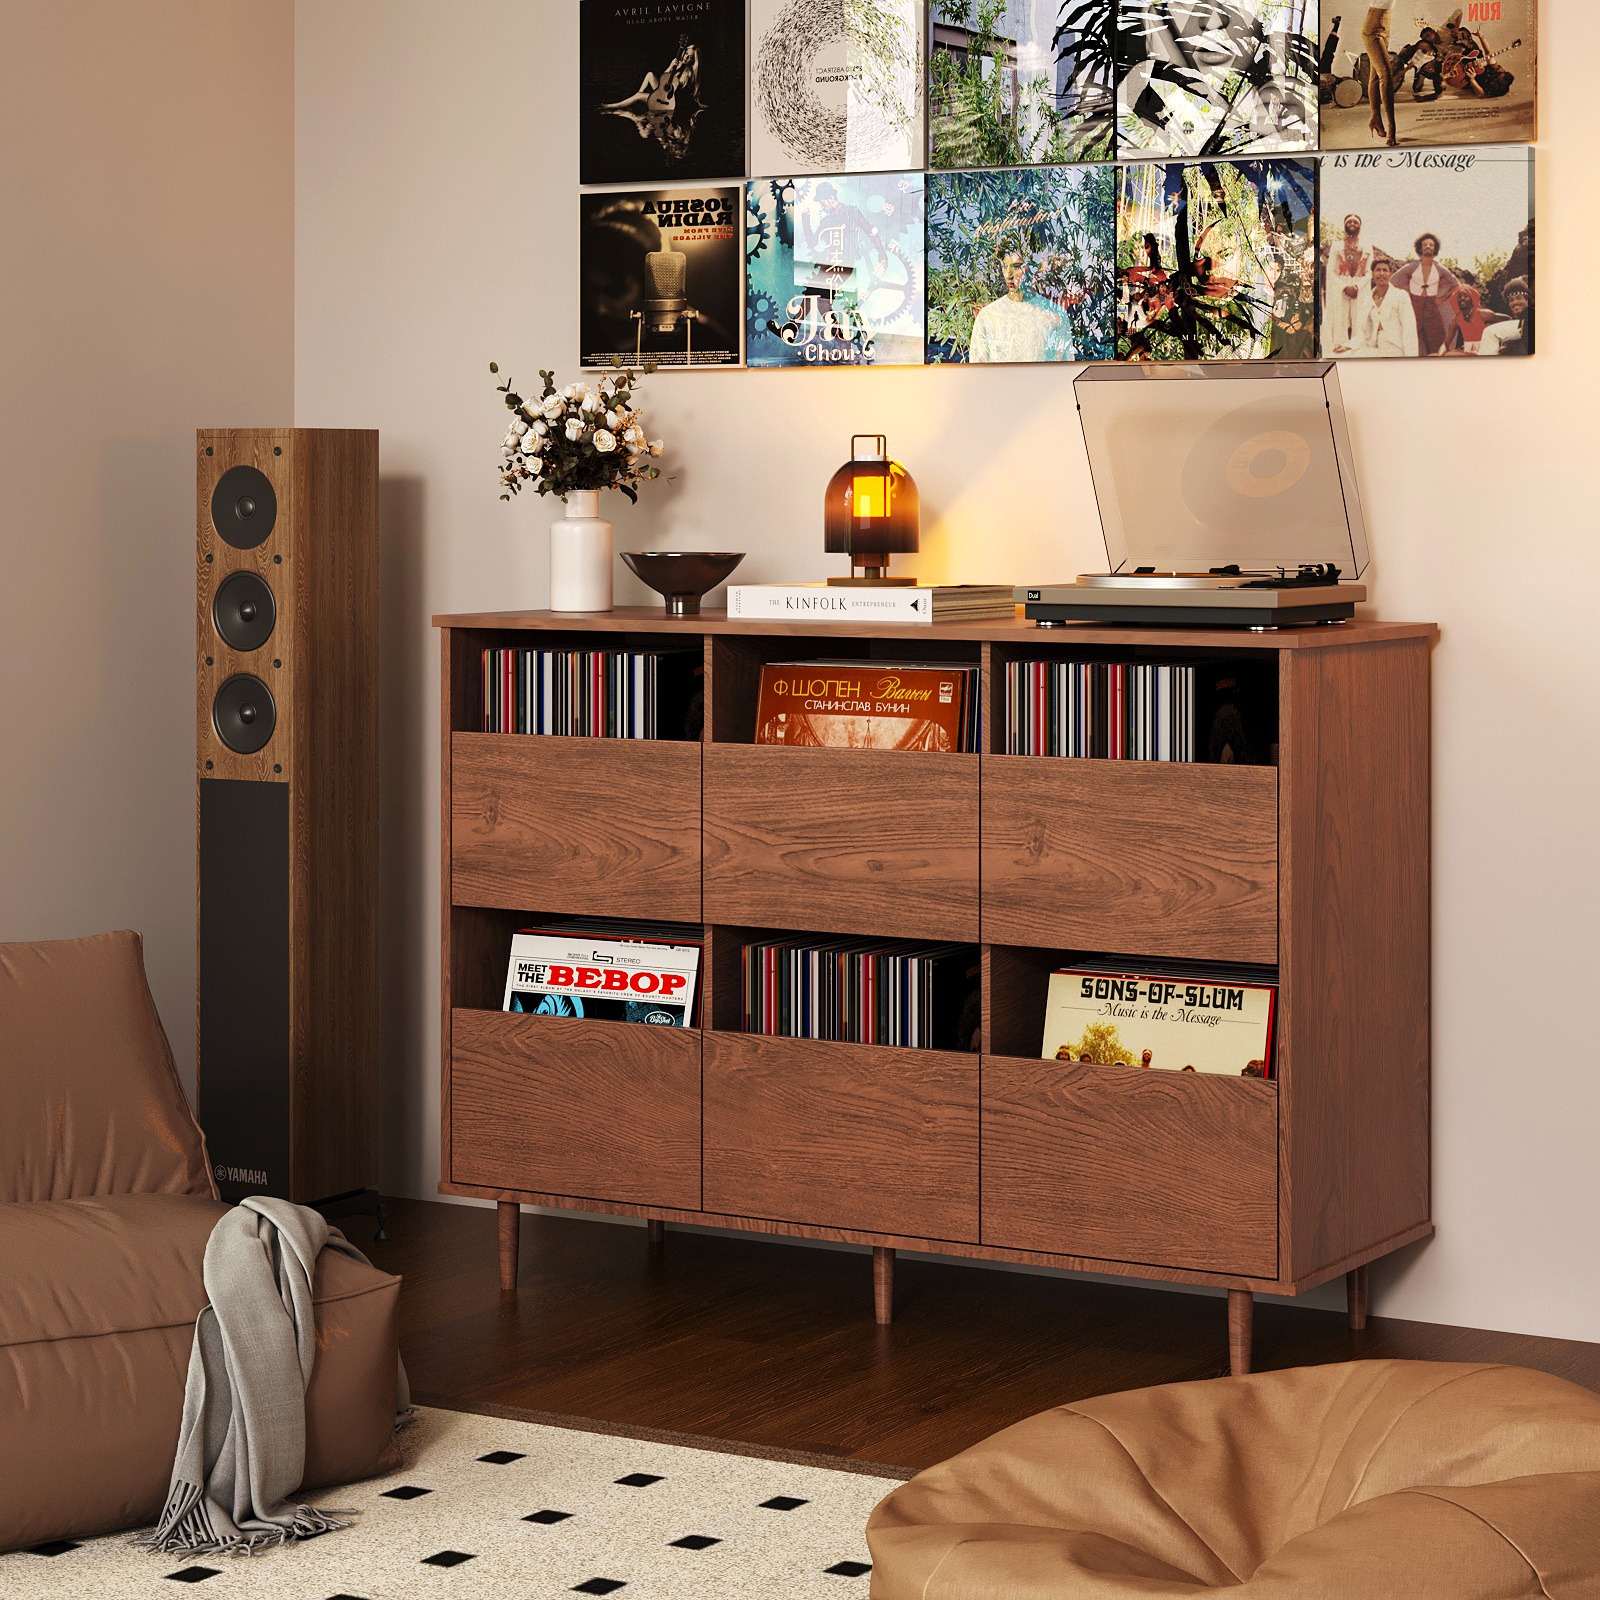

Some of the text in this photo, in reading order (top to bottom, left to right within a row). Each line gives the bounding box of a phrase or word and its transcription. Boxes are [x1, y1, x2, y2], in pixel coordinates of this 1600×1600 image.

[614, 2, 711, 17] AVRIL LAVIGNE
[1386, 151, 1475, 173] Message
[779, 294, 885, 361] Jay
[804, 343, 857, 362] Chou
[786, 596, 848, 611] KINFOLK
[851, 600, 897, 608] ENTREPRENEUR
[869, 676, 933, 702] Вальсы
[804, 699, 911, 714] СТАНИСЛАВ БУНИН
[518, 963, 548, 973] MEET
[616, 957, 642, 965] STEREO
[517, 971, 545, 984] THE
[547, 965, 686, 995] BEBOP
[1080, 977, 1244, 1010] SONS-OF-SLUM
[1097, 1002, 1223, 1028] Music is the Message
[227, 1166, 268, 1186] YAMAHA
